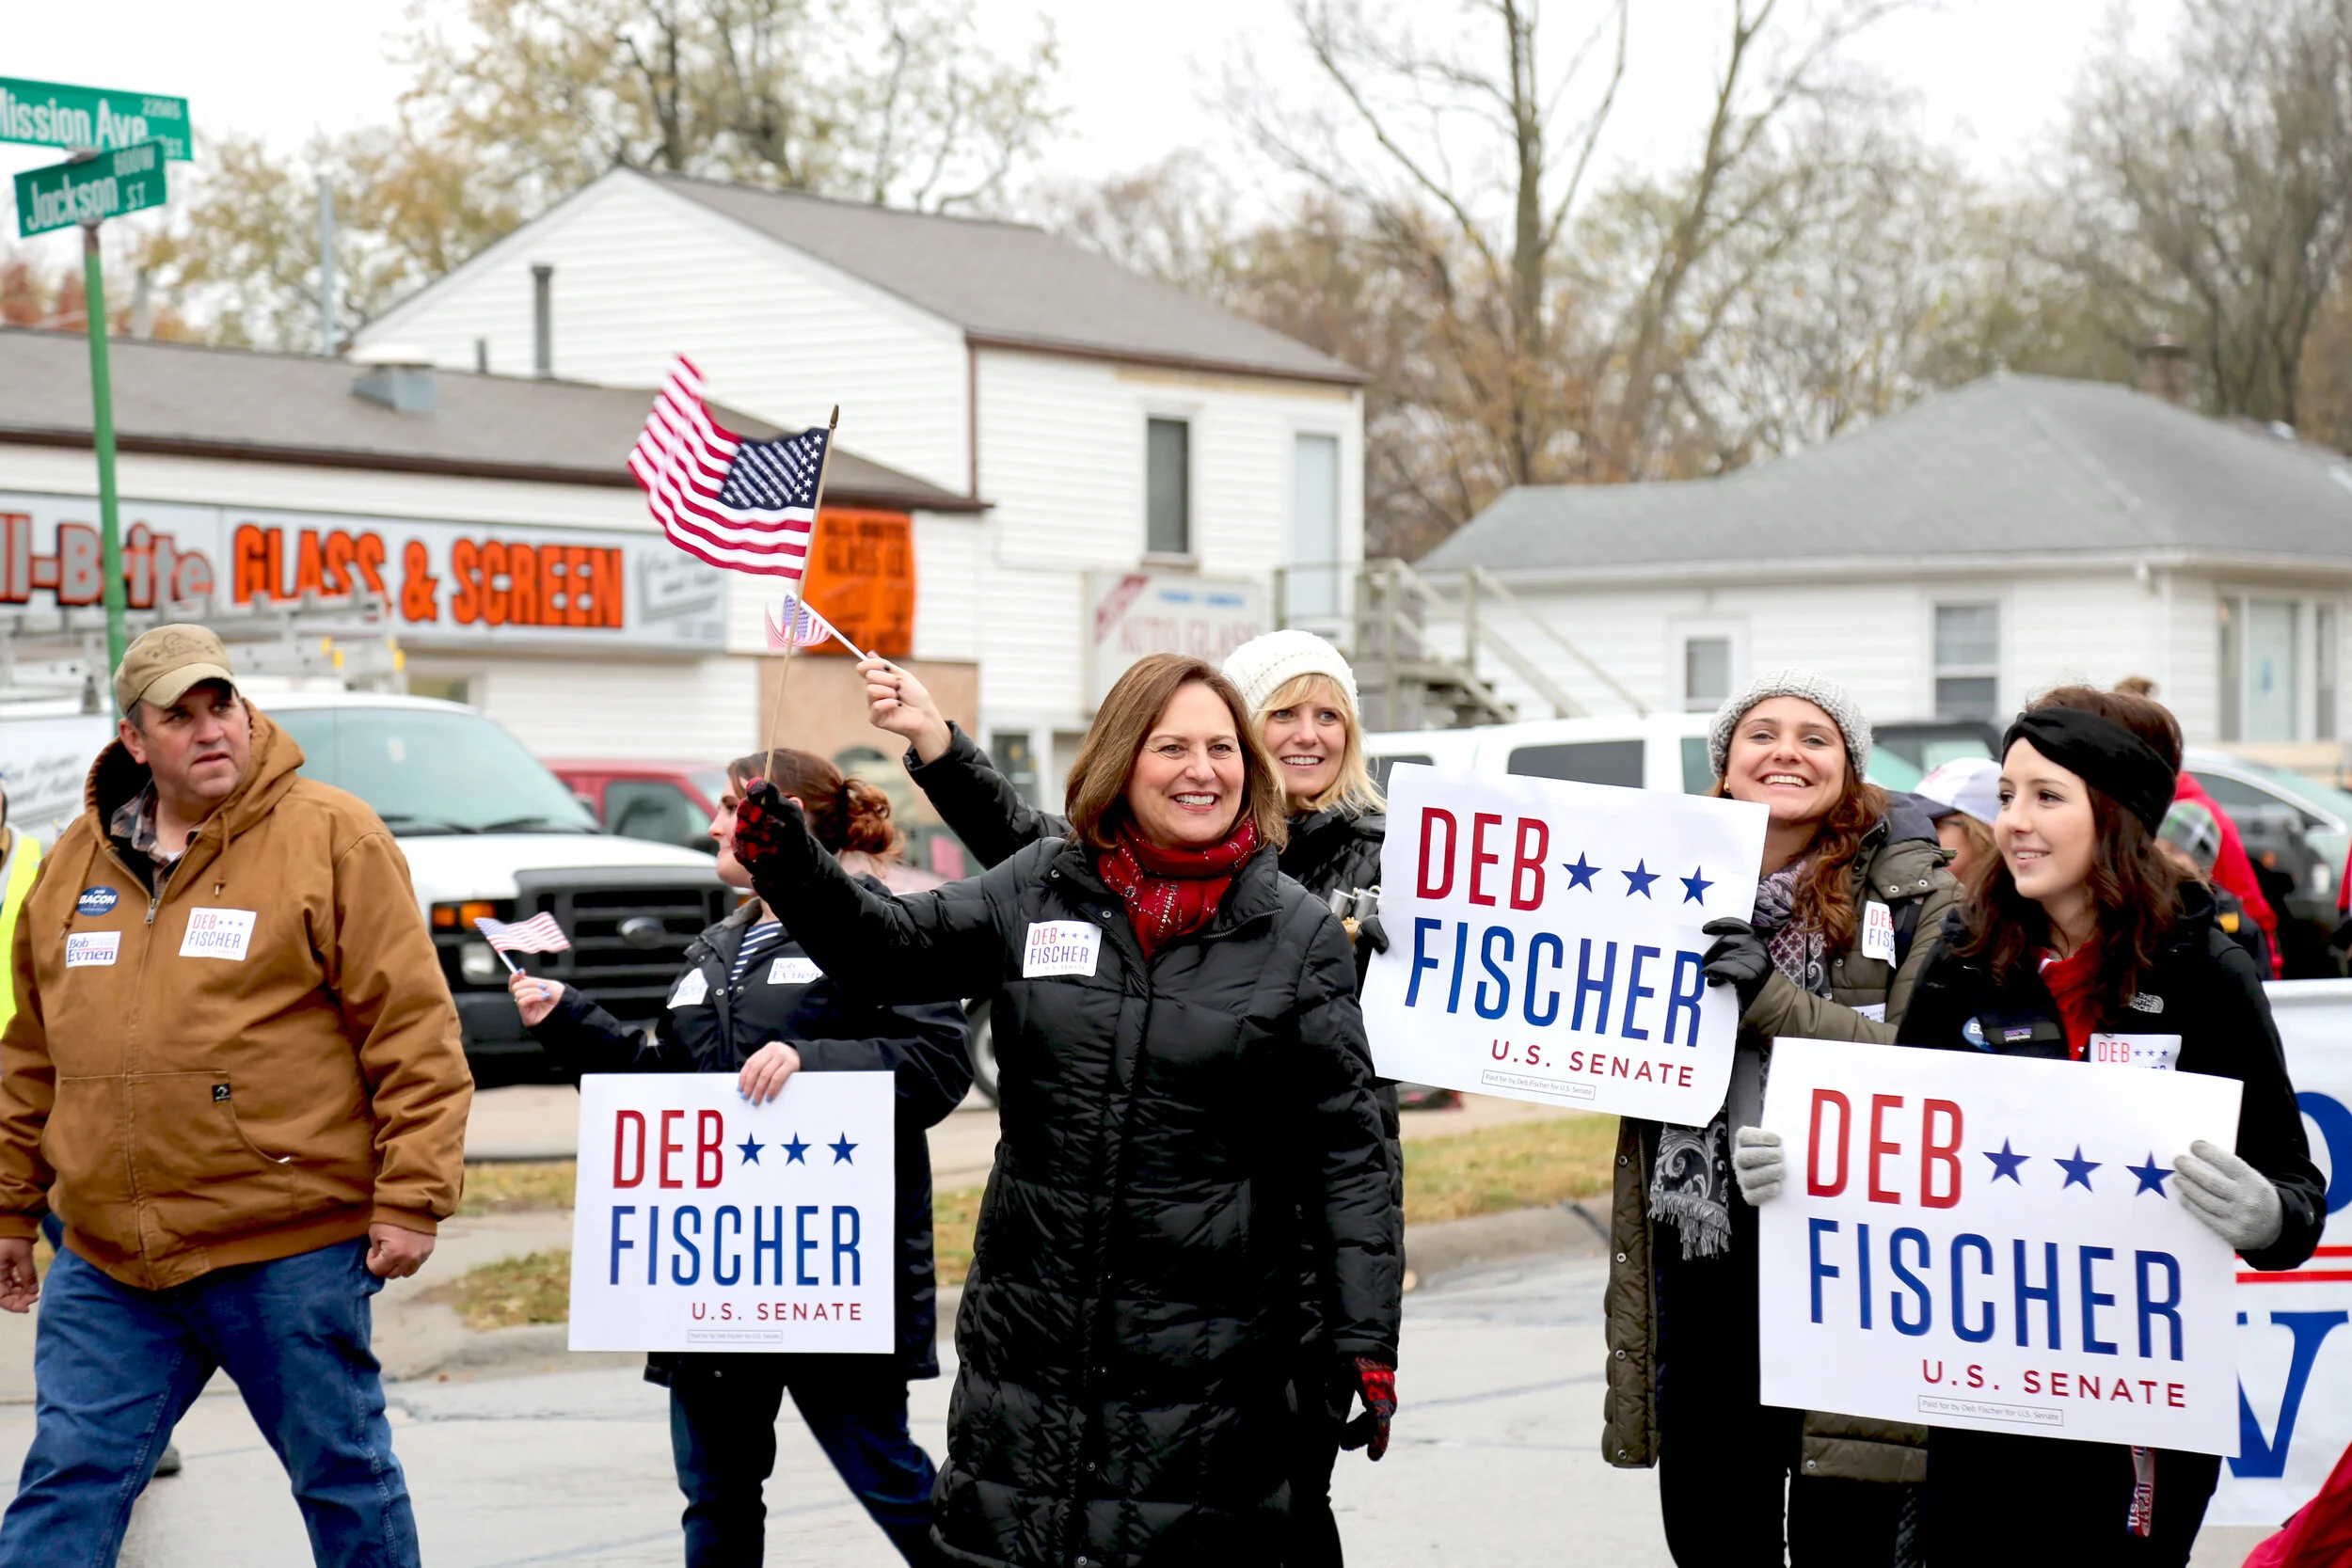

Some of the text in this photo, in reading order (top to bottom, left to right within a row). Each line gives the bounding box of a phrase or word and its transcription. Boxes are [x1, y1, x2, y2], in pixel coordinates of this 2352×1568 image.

[96, 98, 149, 150] Ave
[26, 173, 147, 231] Jackson ST
[233, 523, 389, 608] GLASS
[402, 539, 439, 624] &
[453, 537, 623, 629] SCREEN
[1416, 806, 1549, 911] DEB
[79, 895, 118, 905] BACON
[192, 913, 217, 929] DEB
[1032, 927, 1057, 945] DEB
[68, 949, 114, 962] Evnen
[69, 938, 89, 949] Bob
[188, 930, 242, 949] FISCHER
[1029, 945, 1089, 965] FISCHER
[1405, 916, 1706, 1047] FISCHER
[1491, 1039, 1693, 1088] U.S. SENATE
[2098, 1042, 2130, 1062] DEB
[1530, 1080, 1549, 1088] Fischer
[1573, 1086, 1592, 1095] Senate
[613, 1109, 723, 1189] DEB
[1807, 1087, 1963, 1210] DEB
[610, 1204, 861, 1287] FISCHER
[1807, 1217, 2185, 1362] FISCHER
[692, 1303, 862, 1321] U.S. SENATE
[1922, 1358, 2185, 1408] U.S. SENATE
[1922, 1400, 1937, 1408] Paid
[1951, 1403, 1960, 1412] by
[1978, 1406, 2003, 1415] Fischer
[2005, 1408, 2014, 1417] for
[2033, 1411, 2058, 1420] Senate
